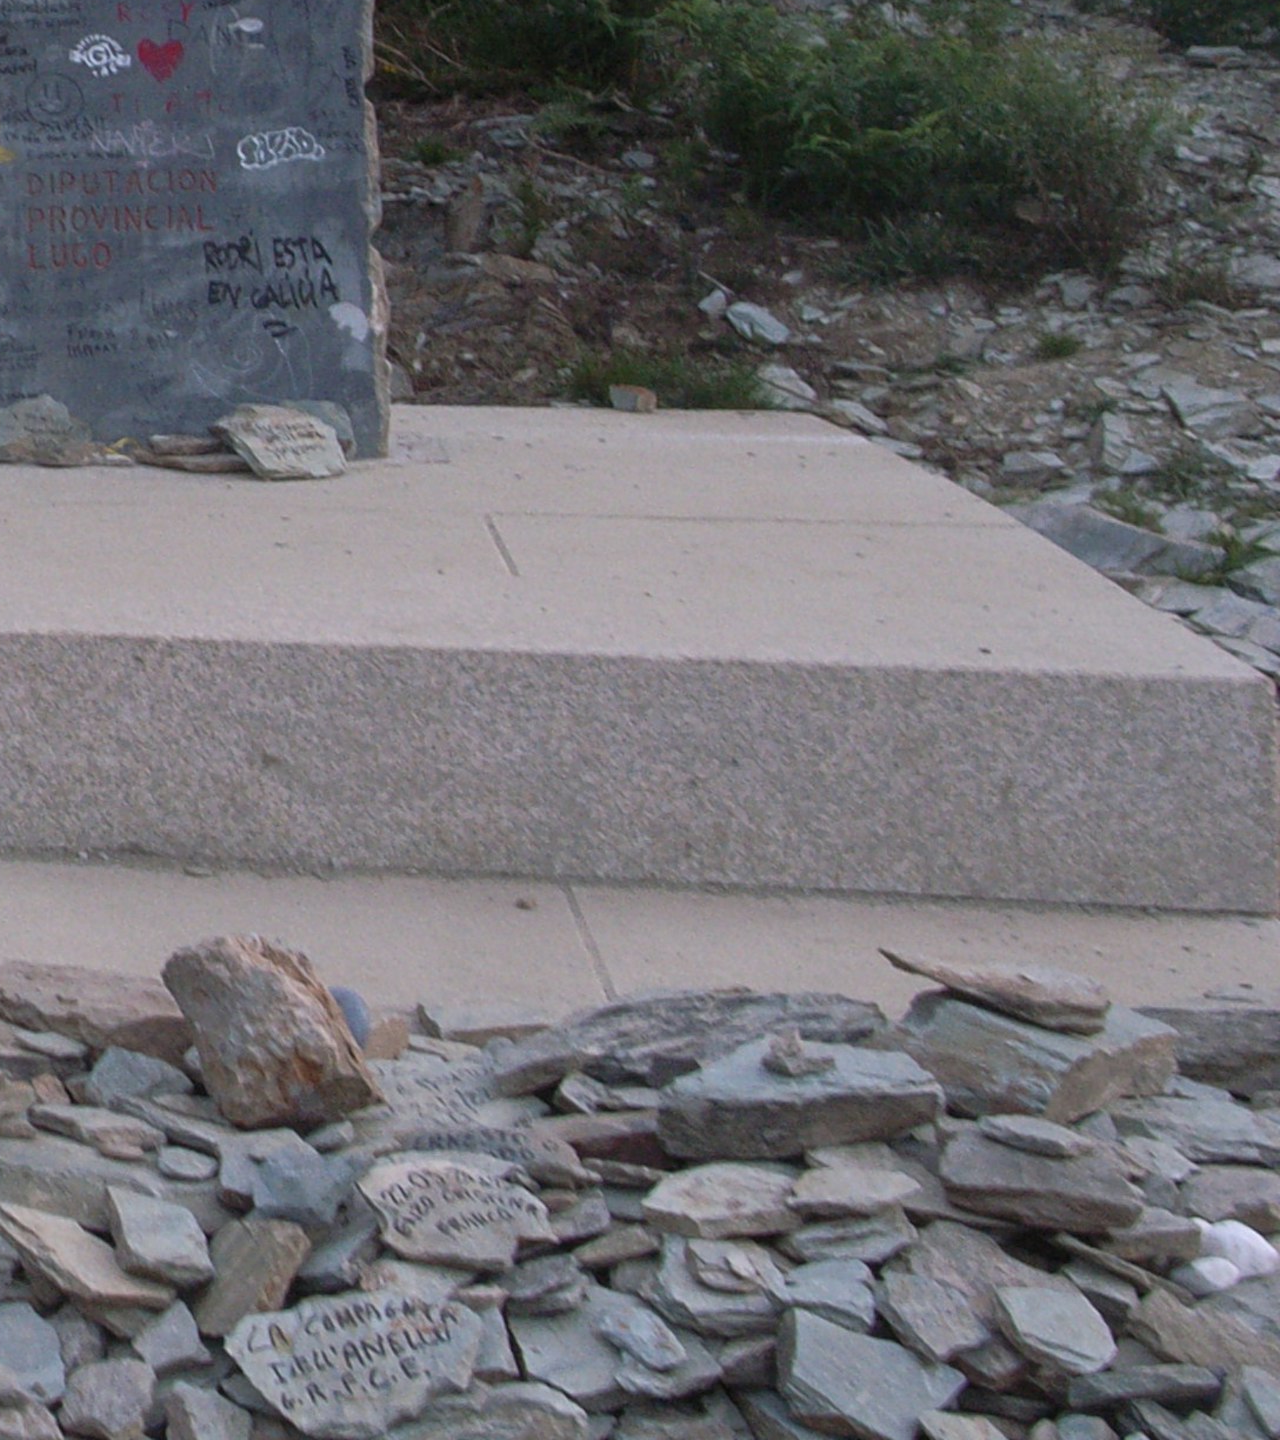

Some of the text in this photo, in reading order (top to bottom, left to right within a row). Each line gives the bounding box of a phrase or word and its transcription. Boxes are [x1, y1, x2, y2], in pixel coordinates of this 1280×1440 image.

[26, 167, 218, 197] DIPUTACION
[27, 205, 216, 234] PROVINCIAL
[27, 241, 113, 271] LUGO
[206, 281, 243, 309] EN
[246, 1322, 290, 1354] LA
